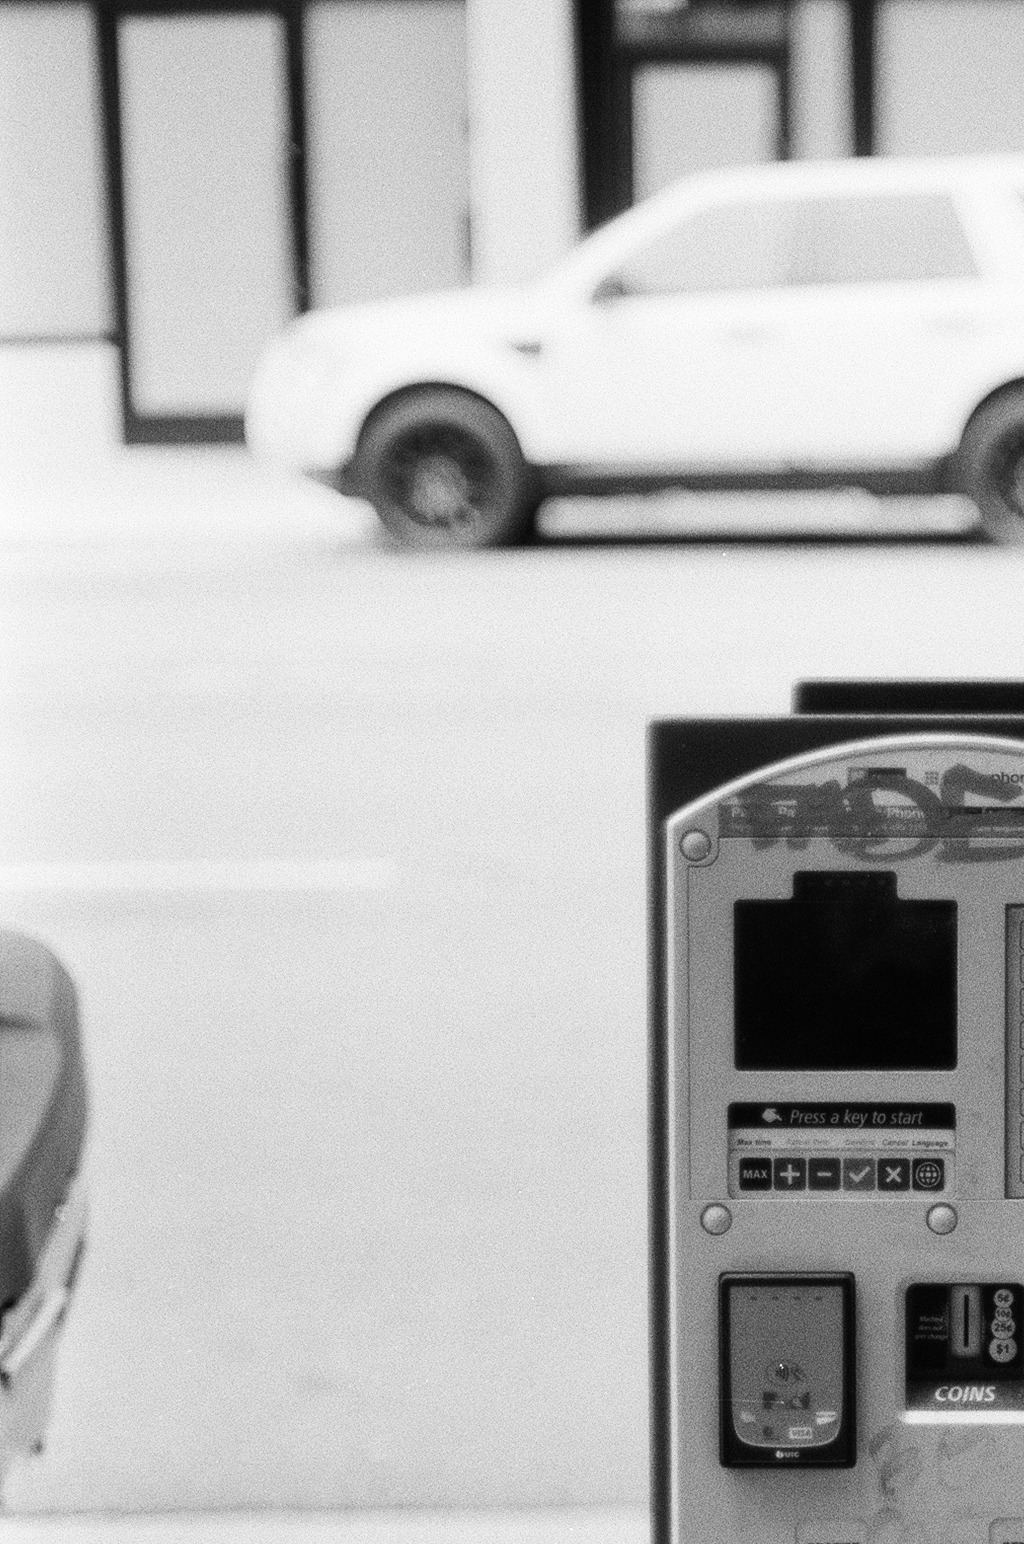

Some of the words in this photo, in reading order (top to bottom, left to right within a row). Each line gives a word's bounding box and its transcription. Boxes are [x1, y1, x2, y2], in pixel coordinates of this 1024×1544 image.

[789, 1109, 827, 1124] Press
[830, 1112, 840, 1124] a
[843, 1109, 868, 1128] key
[871, 1111, 887, 1124] to
[890, 1111, 924, 1125] start
[742, 1169, 768, 1180] MAX
[996, 1343, 1010, 1355] $1
[934, 1386, 996, 1402] COINS
